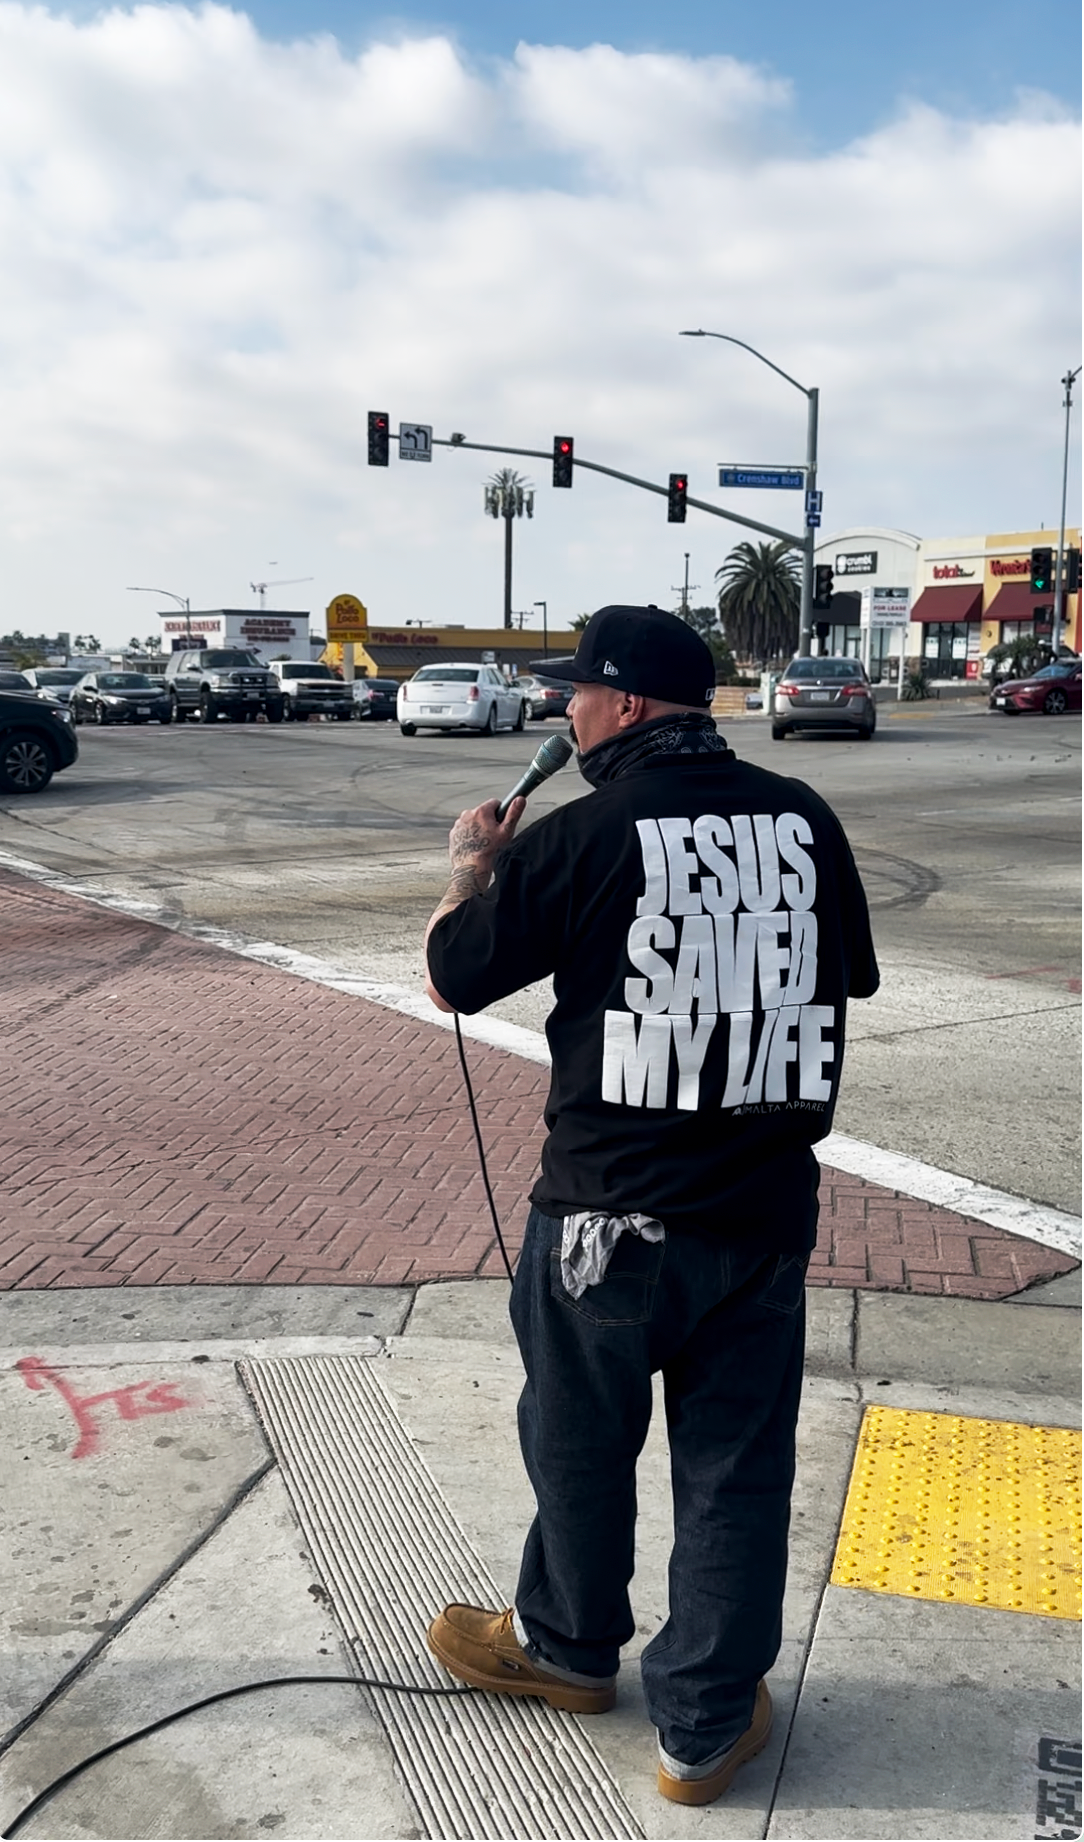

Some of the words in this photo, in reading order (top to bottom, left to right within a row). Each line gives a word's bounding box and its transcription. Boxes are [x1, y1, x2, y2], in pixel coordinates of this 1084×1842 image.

[737, 473, 779, 485] Crenshaw
[781, 475, 800, 485] Blvd
[335, 603, 359, 615] Pollo
[337, 614, 359, 623] Loco
[635, 812, 817, 916] JESUS
[624, 910, 818, 1014] SAVED
[601, 1009, 717, 1111] MY
[720, 1005, 835, 1109] LIFE
[785, 1101, 825, 1112] APPAREL
